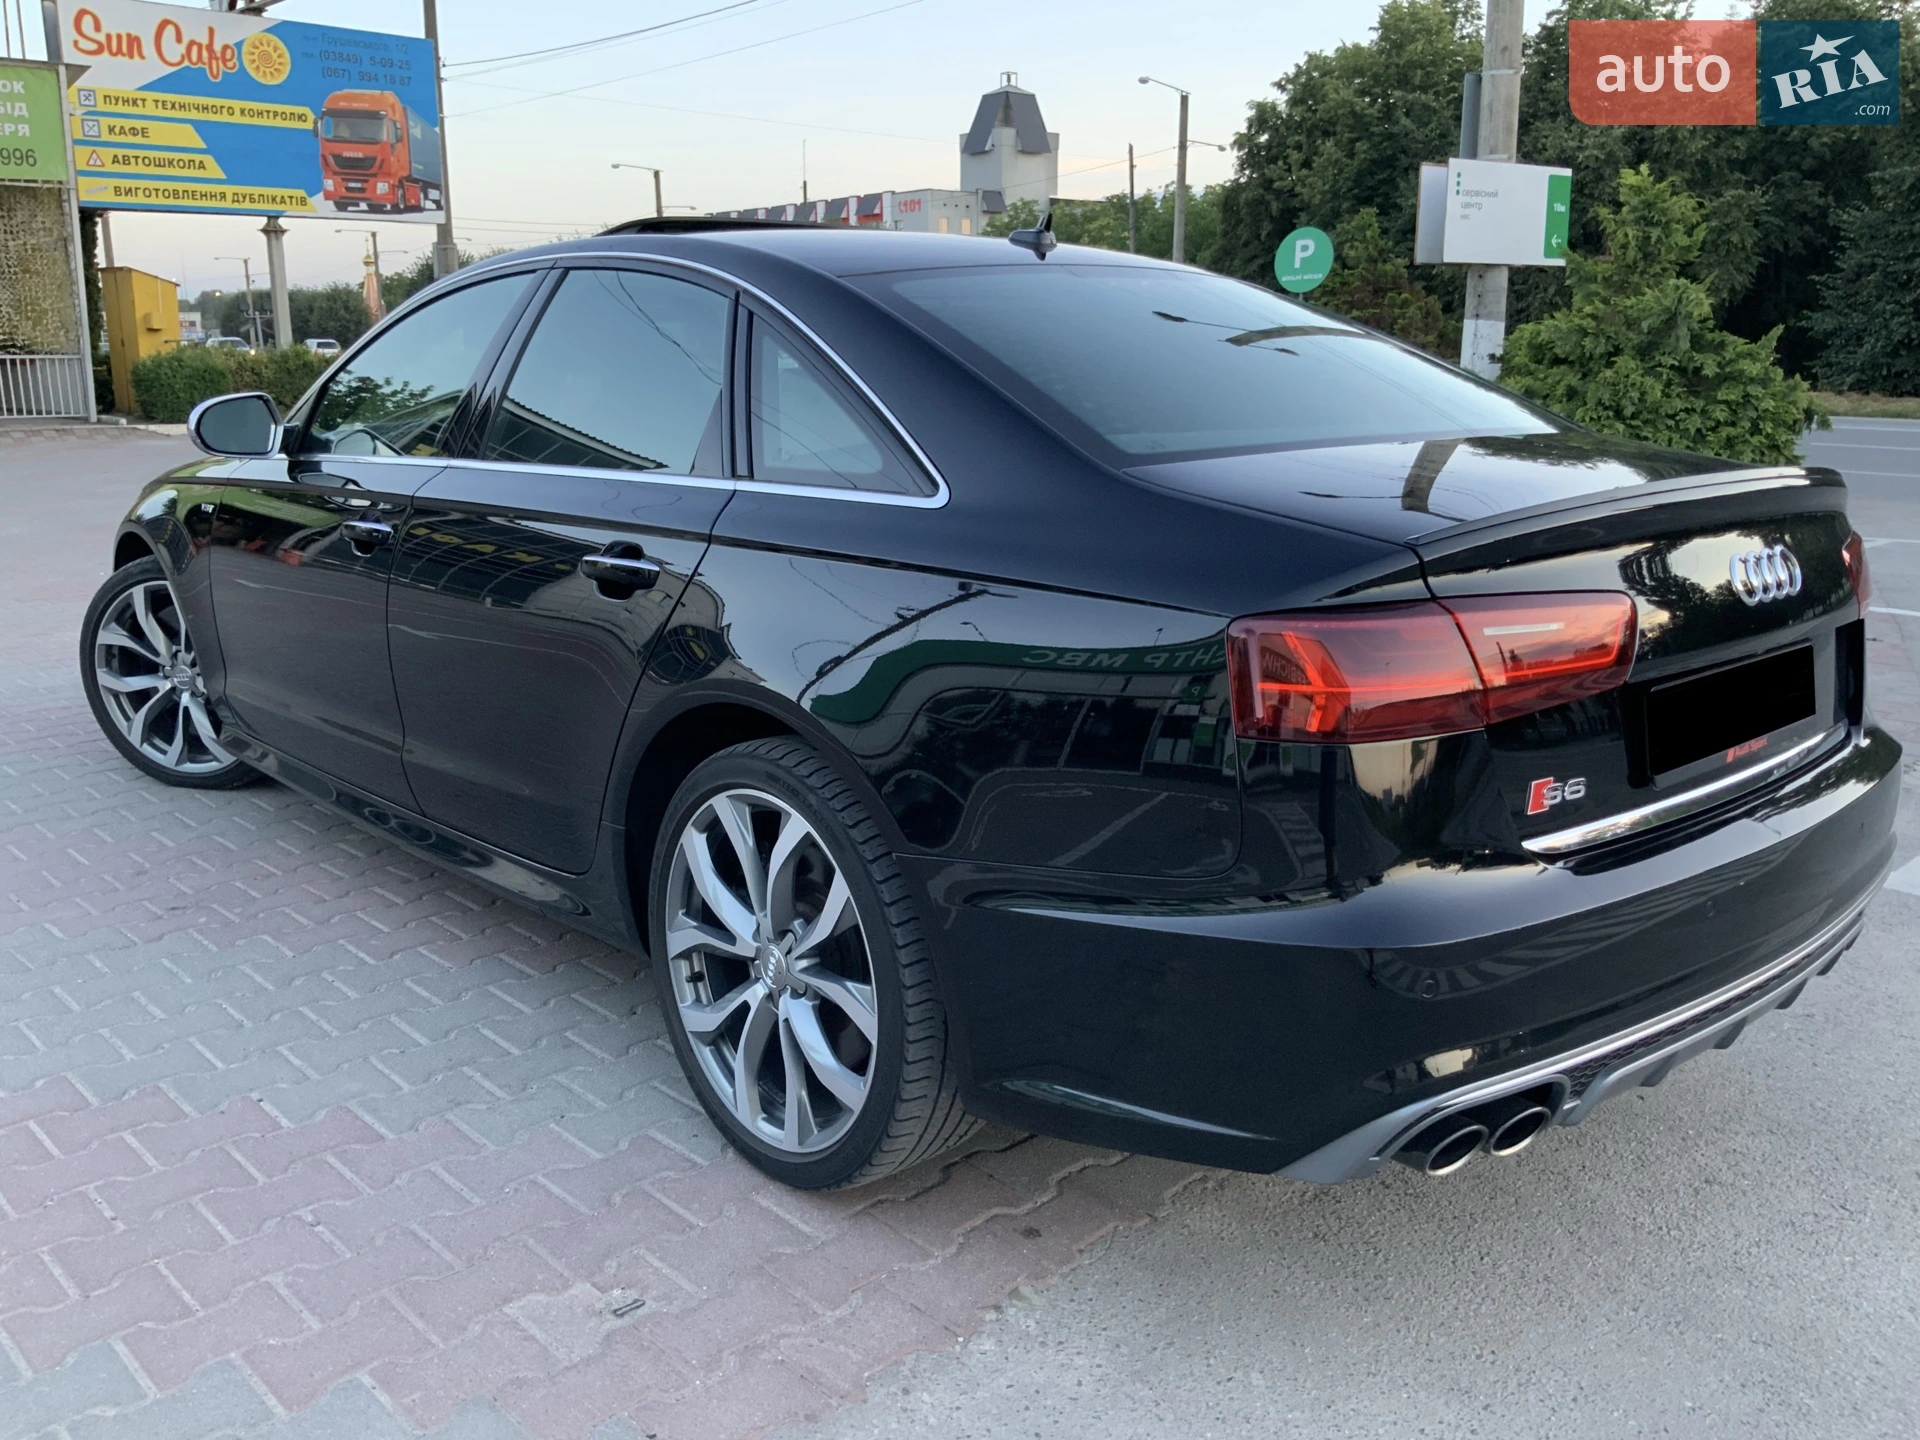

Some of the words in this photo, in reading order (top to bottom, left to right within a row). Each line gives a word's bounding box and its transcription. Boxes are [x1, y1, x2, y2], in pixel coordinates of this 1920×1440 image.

[73, 8, 146, 60] Sun
[154, 18, 238, 80] Cafe
[319, 49, 363, 67] (03849)
[369, 56, 411, 71] 5-09-25
[322, 66, 351, 82] (067)
[358, 70, 379, 83] 994
[384, 73, 396, 85] 18
[103, 95, 147, 108] ПУНКТ
[153, 99, 235, 116] ТЕХНІЧНОГО
[240, 107, 308, 123] КОНТРОЛЮ
[0, 123, 30, 137] РЯ
[108, 124, 150, 138] КАФЕ
[0, 147, 37, 167] 996
[111, 154, 207, 171] АВТОШКОЛА
[113, 186, 227, 203] ВИГОТОВЛЕННЯ
[232, 192, 308, 207] ДУБЛІКАТІВ
[1462, 188, 1499, 198] сервісний
[1461, 202, 1483, 211] центр
[1294, 239, 1315, 269] P
[1543, 777, 1586, 806] S6
